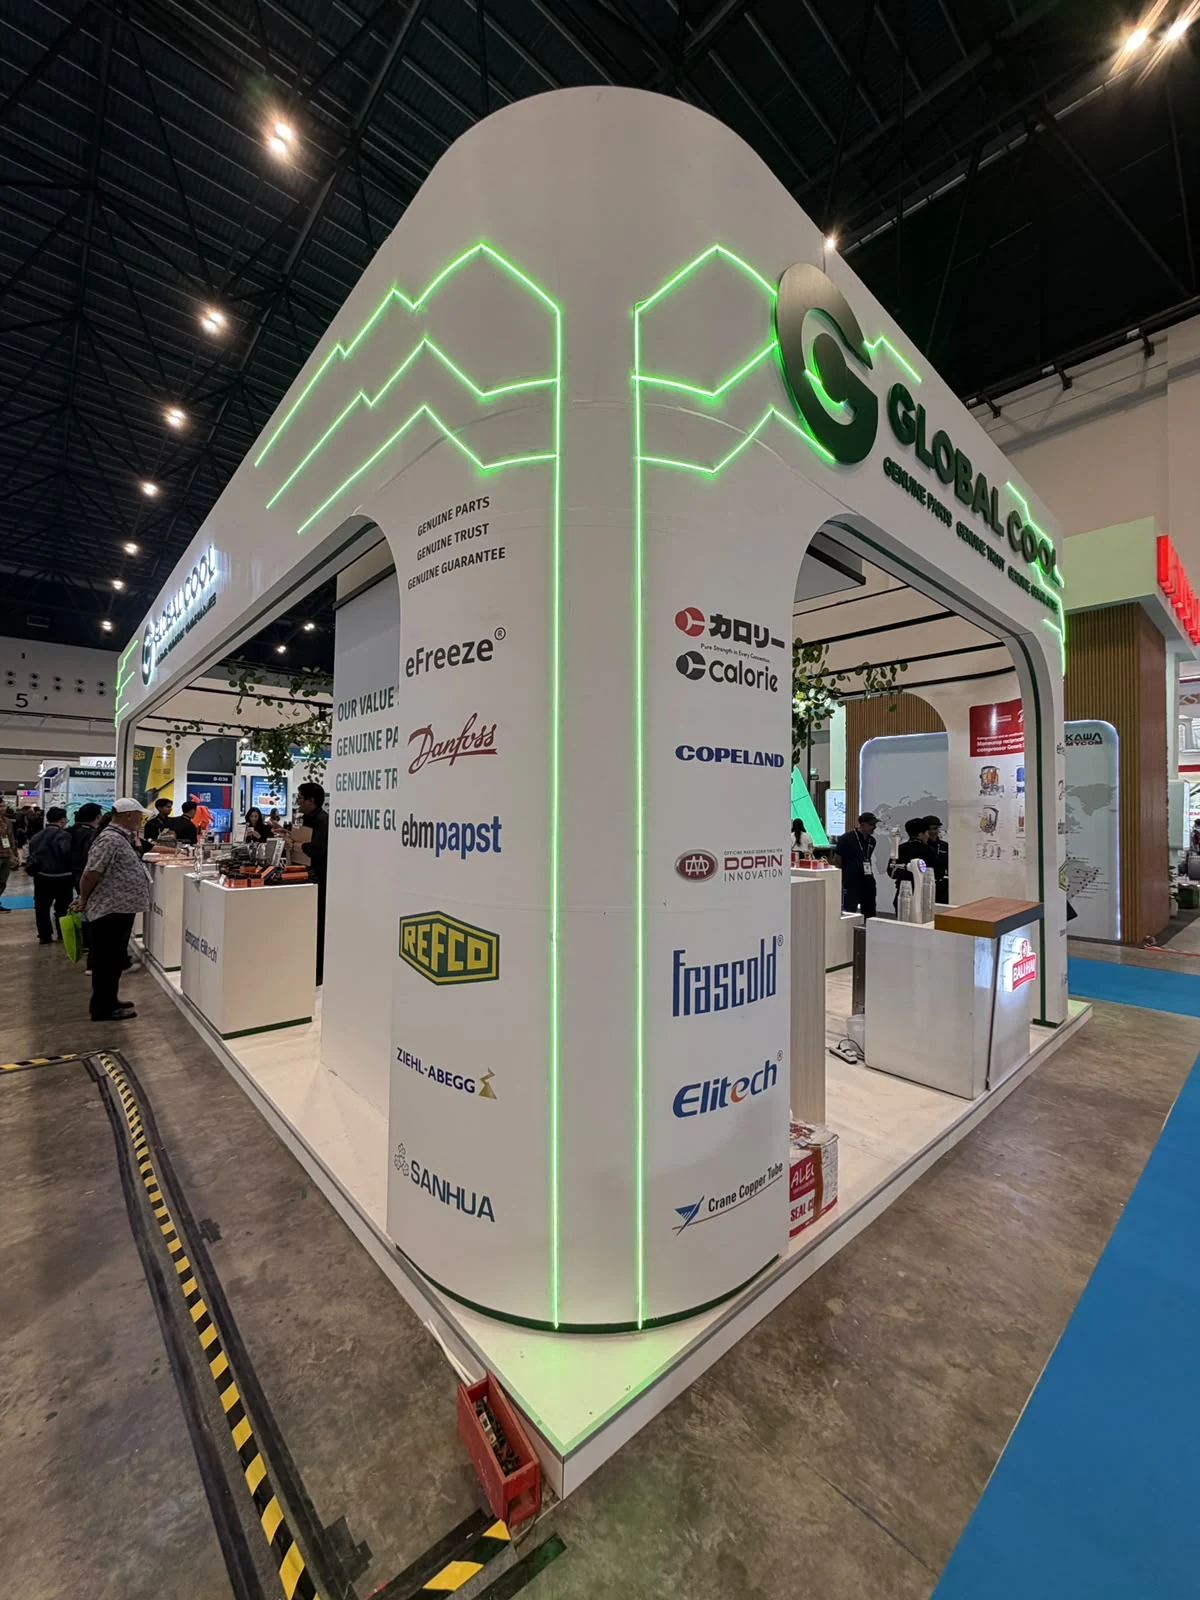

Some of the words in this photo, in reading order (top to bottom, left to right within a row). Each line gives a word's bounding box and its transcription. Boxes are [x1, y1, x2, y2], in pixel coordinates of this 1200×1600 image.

[887, 382, 1004, 537] GLOBAL
[883, 457, 926, 506] GENUINE
[927, 492, 953, 528] PARTS
[418, 509, 453, 536] GENUINE
[455, 496, 490, 517] PARTS
[417, 535, 452, 560] GENUINE
[454, 523, 489, 543] TRUST
[407, 562, 439, 590] GENUINE
[441, 547, 505, 574] GUARANTEE
[709, 613, 785, 649] カロリー
[709, 660, 779, 693] calorie
[15, 693, 28, 708] 5
[337, 699, 357, 722] OUR
[337, 730, 382, 757] GENUINE
[408, 712, 498, 774] Danfoss
[675, 745, 785, 768] COPELAND
[336, 769, 381, 792] GENUINE
[335, 808, 380, 830] GENUINE
[402, 813, 502, 859] ebmpapst
[724, 855, 782, 870] DORIN
[724, 869, 783, 882] INNOVATION
[404, 922, 488, 972] REFCO
[397, 1047, 475, 1094] ZIEHL-ABEGG
[411, 1159, 495, 1223] SANHUA
[708, 1191, 737, 1212] Crane
[739, 1174, 766, 1198] Copper
[767, 1162, 783, 1181] Tube
